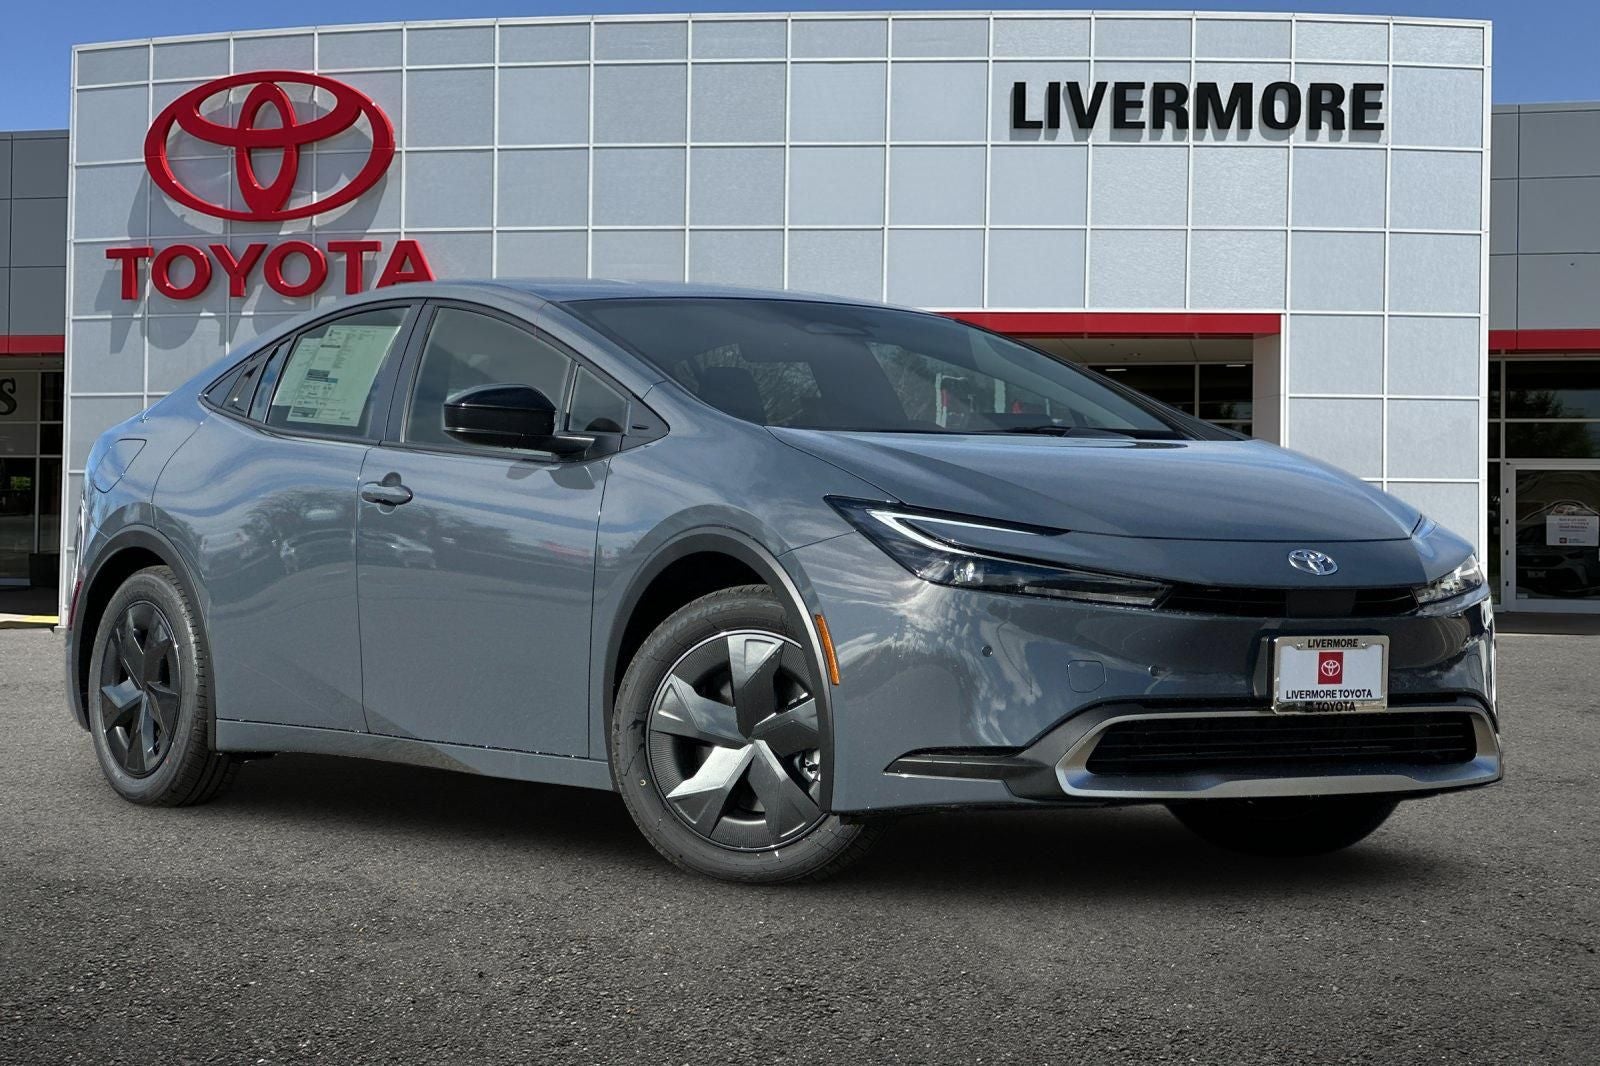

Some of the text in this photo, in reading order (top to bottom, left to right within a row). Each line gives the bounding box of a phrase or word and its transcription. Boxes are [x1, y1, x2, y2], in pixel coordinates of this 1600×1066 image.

[1012, 81, 1385, 131] LIVERMORE
[106, 240, 436, 300] TOYOTA
[1307, 638, 1359, 648] LIVERMORE
[1286, 689, 1373, 700] LIVERMORE TOYOTA
[1315, 701, 1356, 712] TOYOTA
